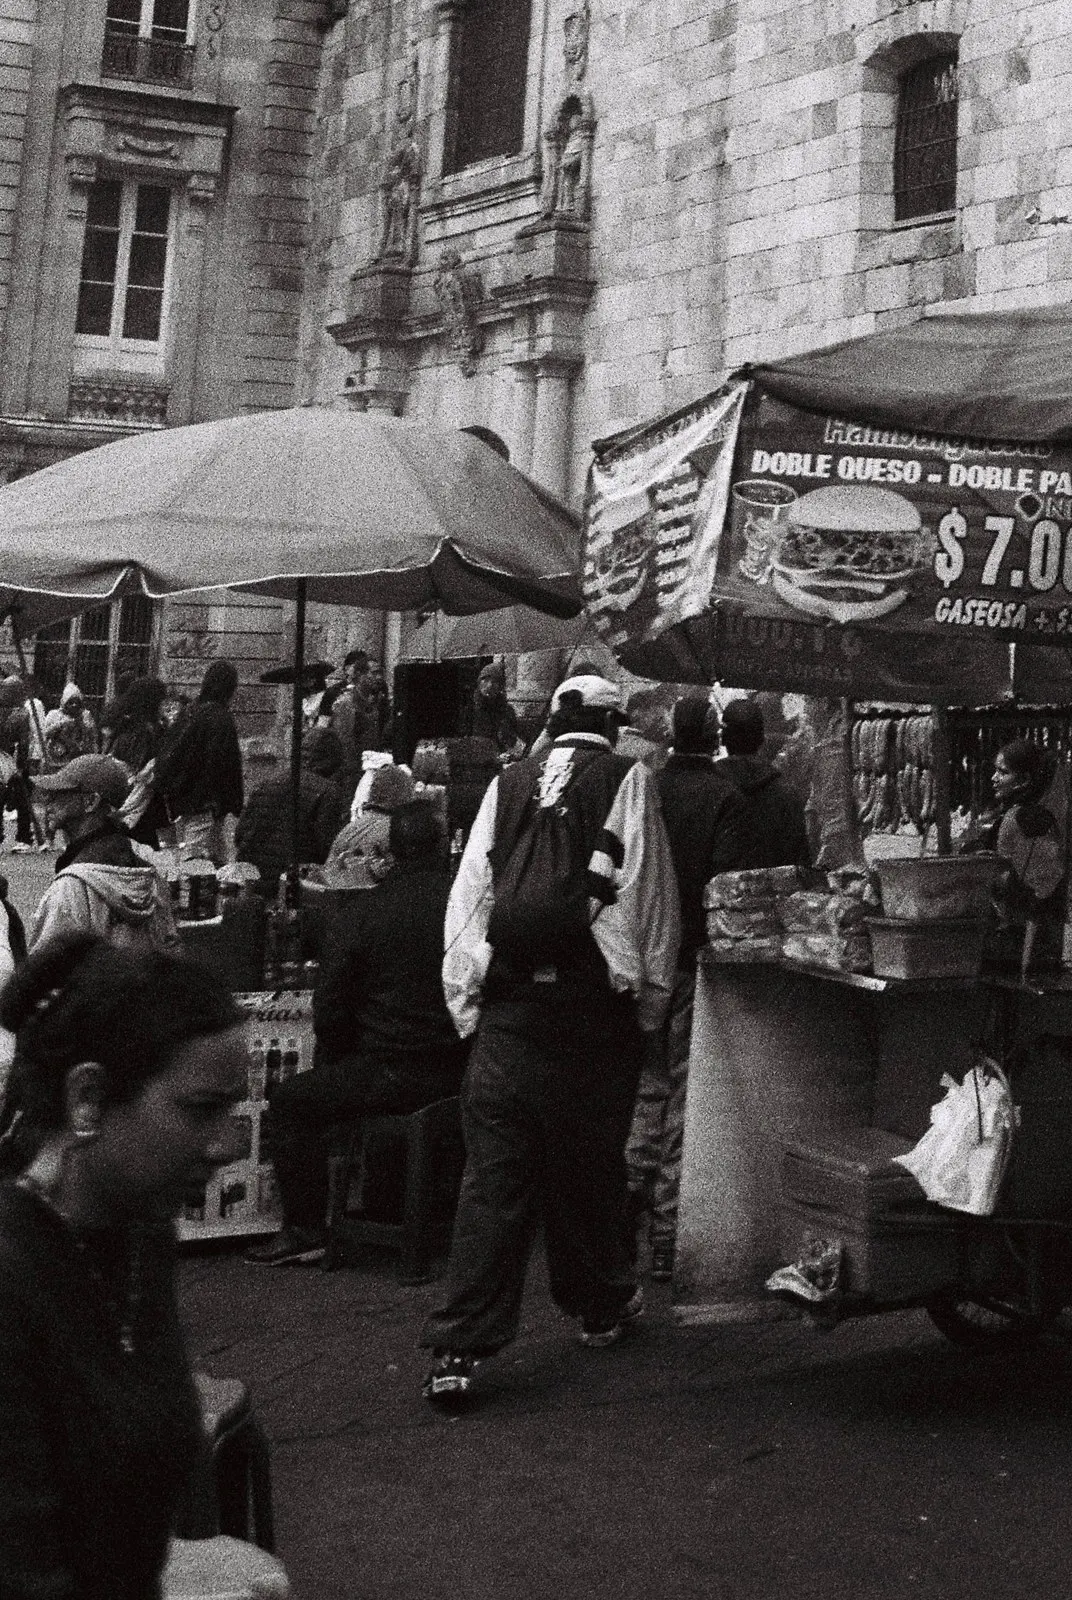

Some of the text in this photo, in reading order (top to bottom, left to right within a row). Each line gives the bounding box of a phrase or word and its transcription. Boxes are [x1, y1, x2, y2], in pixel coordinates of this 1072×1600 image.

[751, 449, 831, 478] DOBLE
[837, 450, 922, 483] QUESO
[949, 462, 1036, 494] DOBLE
[935, 597, 1027, 629] GASEOSA
